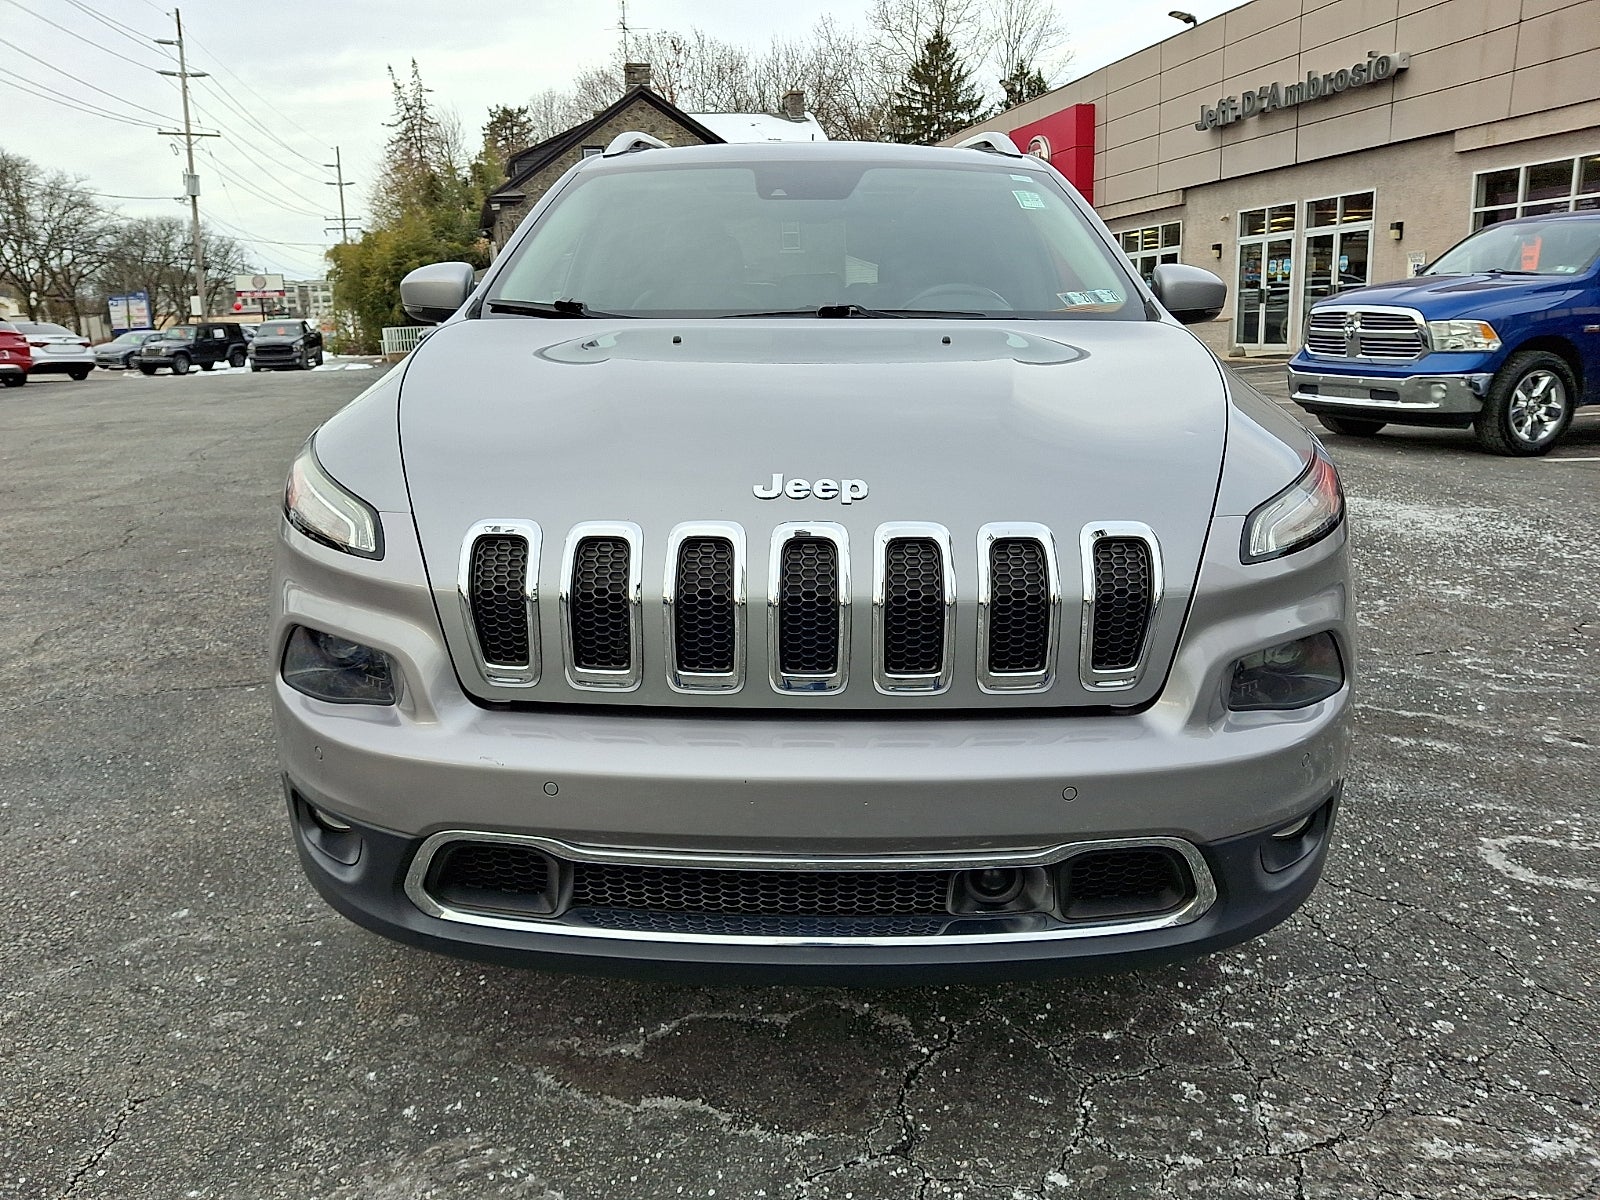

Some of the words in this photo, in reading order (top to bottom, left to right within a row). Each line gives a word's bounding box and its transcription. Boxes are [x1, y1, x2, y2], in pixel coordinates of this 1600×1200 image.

[1195, 96, 1241, 131] Jeff
[1241, 51, 1393, 120] D'Ambrosio
[753, 473, 868, 505] Jeep
